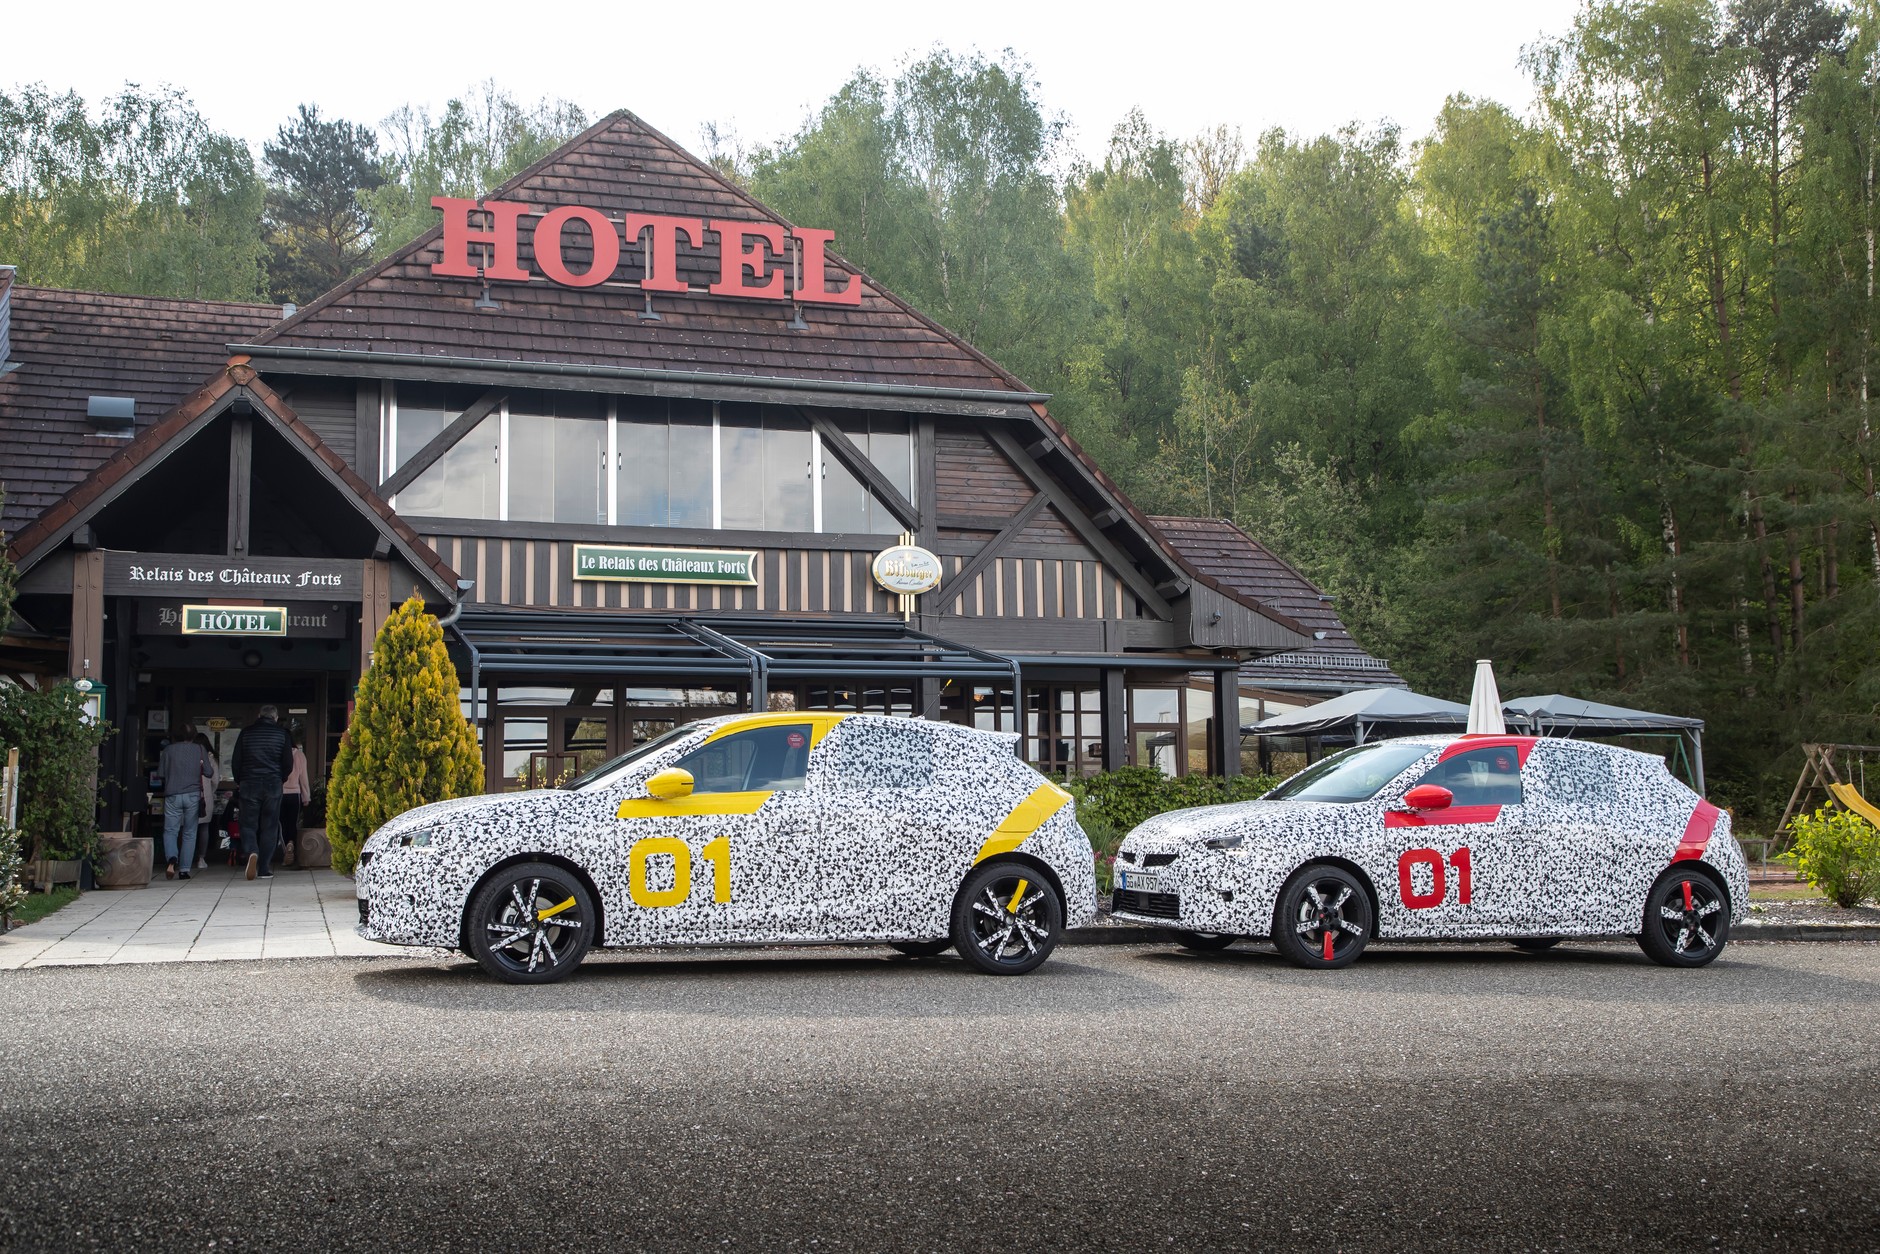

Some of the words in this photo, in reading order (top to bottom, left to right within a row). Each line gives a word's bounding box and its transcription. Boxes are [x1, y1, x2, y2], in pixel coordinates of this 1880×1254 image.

[430, 196, 862, 306] HOTEL
[581, 555, 596, 569] Le
[599, 556, 635, 571] Relais
[638, 558, 659, 572] des
[661, 557, 714, 573] Châteaux
[717, 560, 746, 575] Forts
[884, 559, 934, 580] Bitburger
[129, 565, 184, 582] Relais
[188, 568, 214, 582] des
[219, 567, 291, 586] Châteaux
[295, 571, 342, 587] Forts
[200, 610, 270, 631] HÔTEL
[629, 836, 731, 908] 01
[1398, 847, 1472, 909] 01
[1146, 876, 1158, 891] 957
